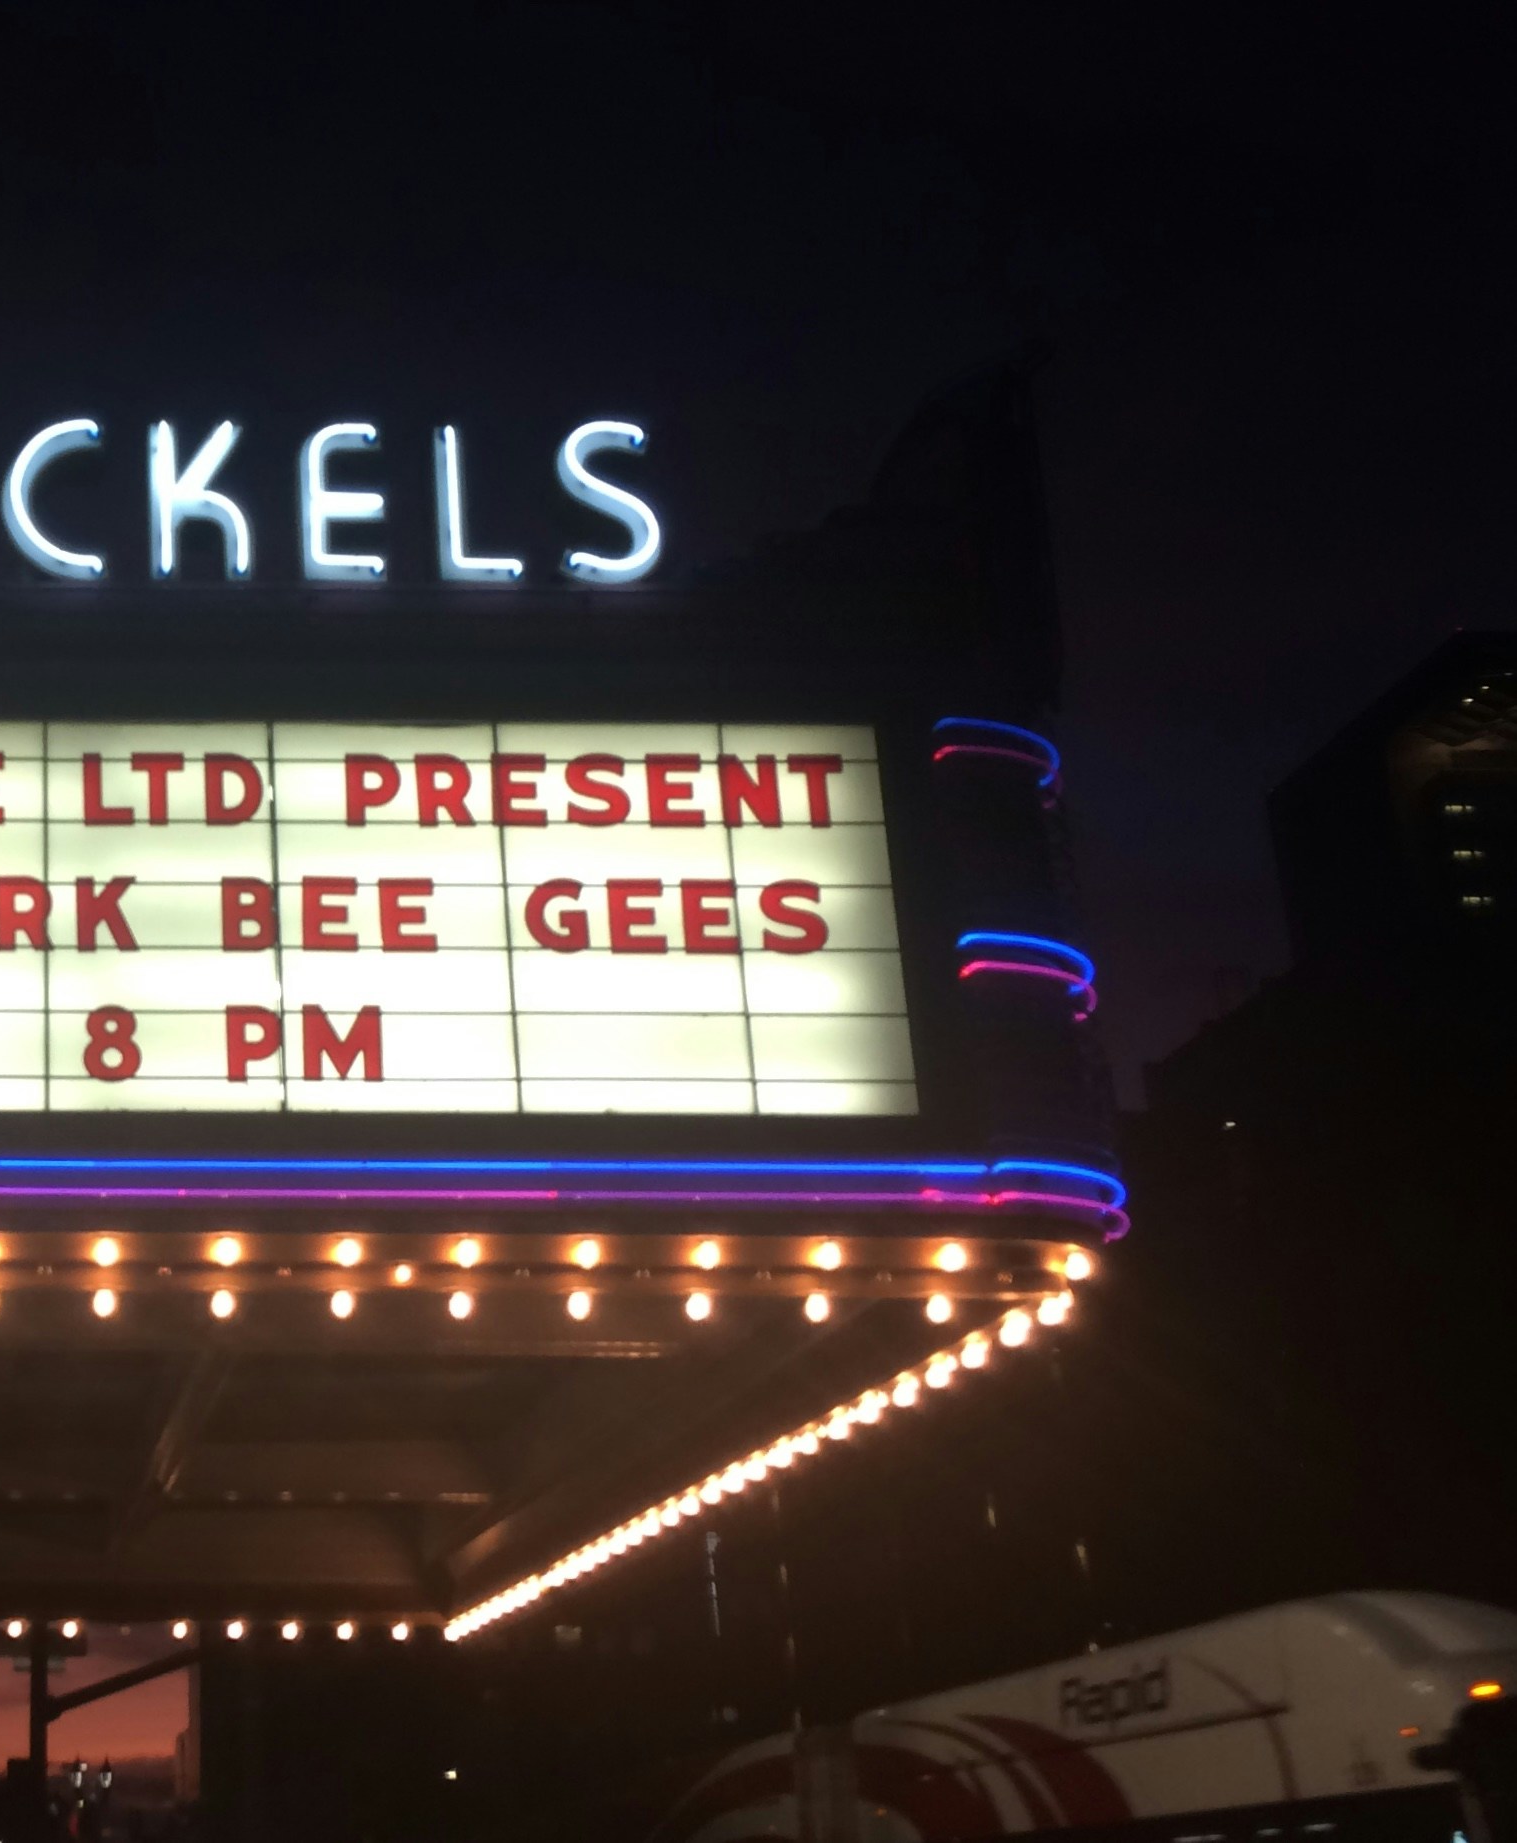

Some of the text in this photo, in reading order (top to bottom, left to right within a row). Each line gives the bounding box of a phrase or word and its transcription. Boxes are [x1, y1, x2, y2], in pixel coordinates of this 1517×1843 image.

[82, 751, 264, 827] LTD
[344, 752, 844, 828] PRESENT
[220, 876, 439, 953] BEE
[524, 878, 830, 955] GEES
[82, 1005, 142, 1082] 8
[225, 1004, 384, 1083] PM
[1058, 1655, 1171, 1730] Rapid
